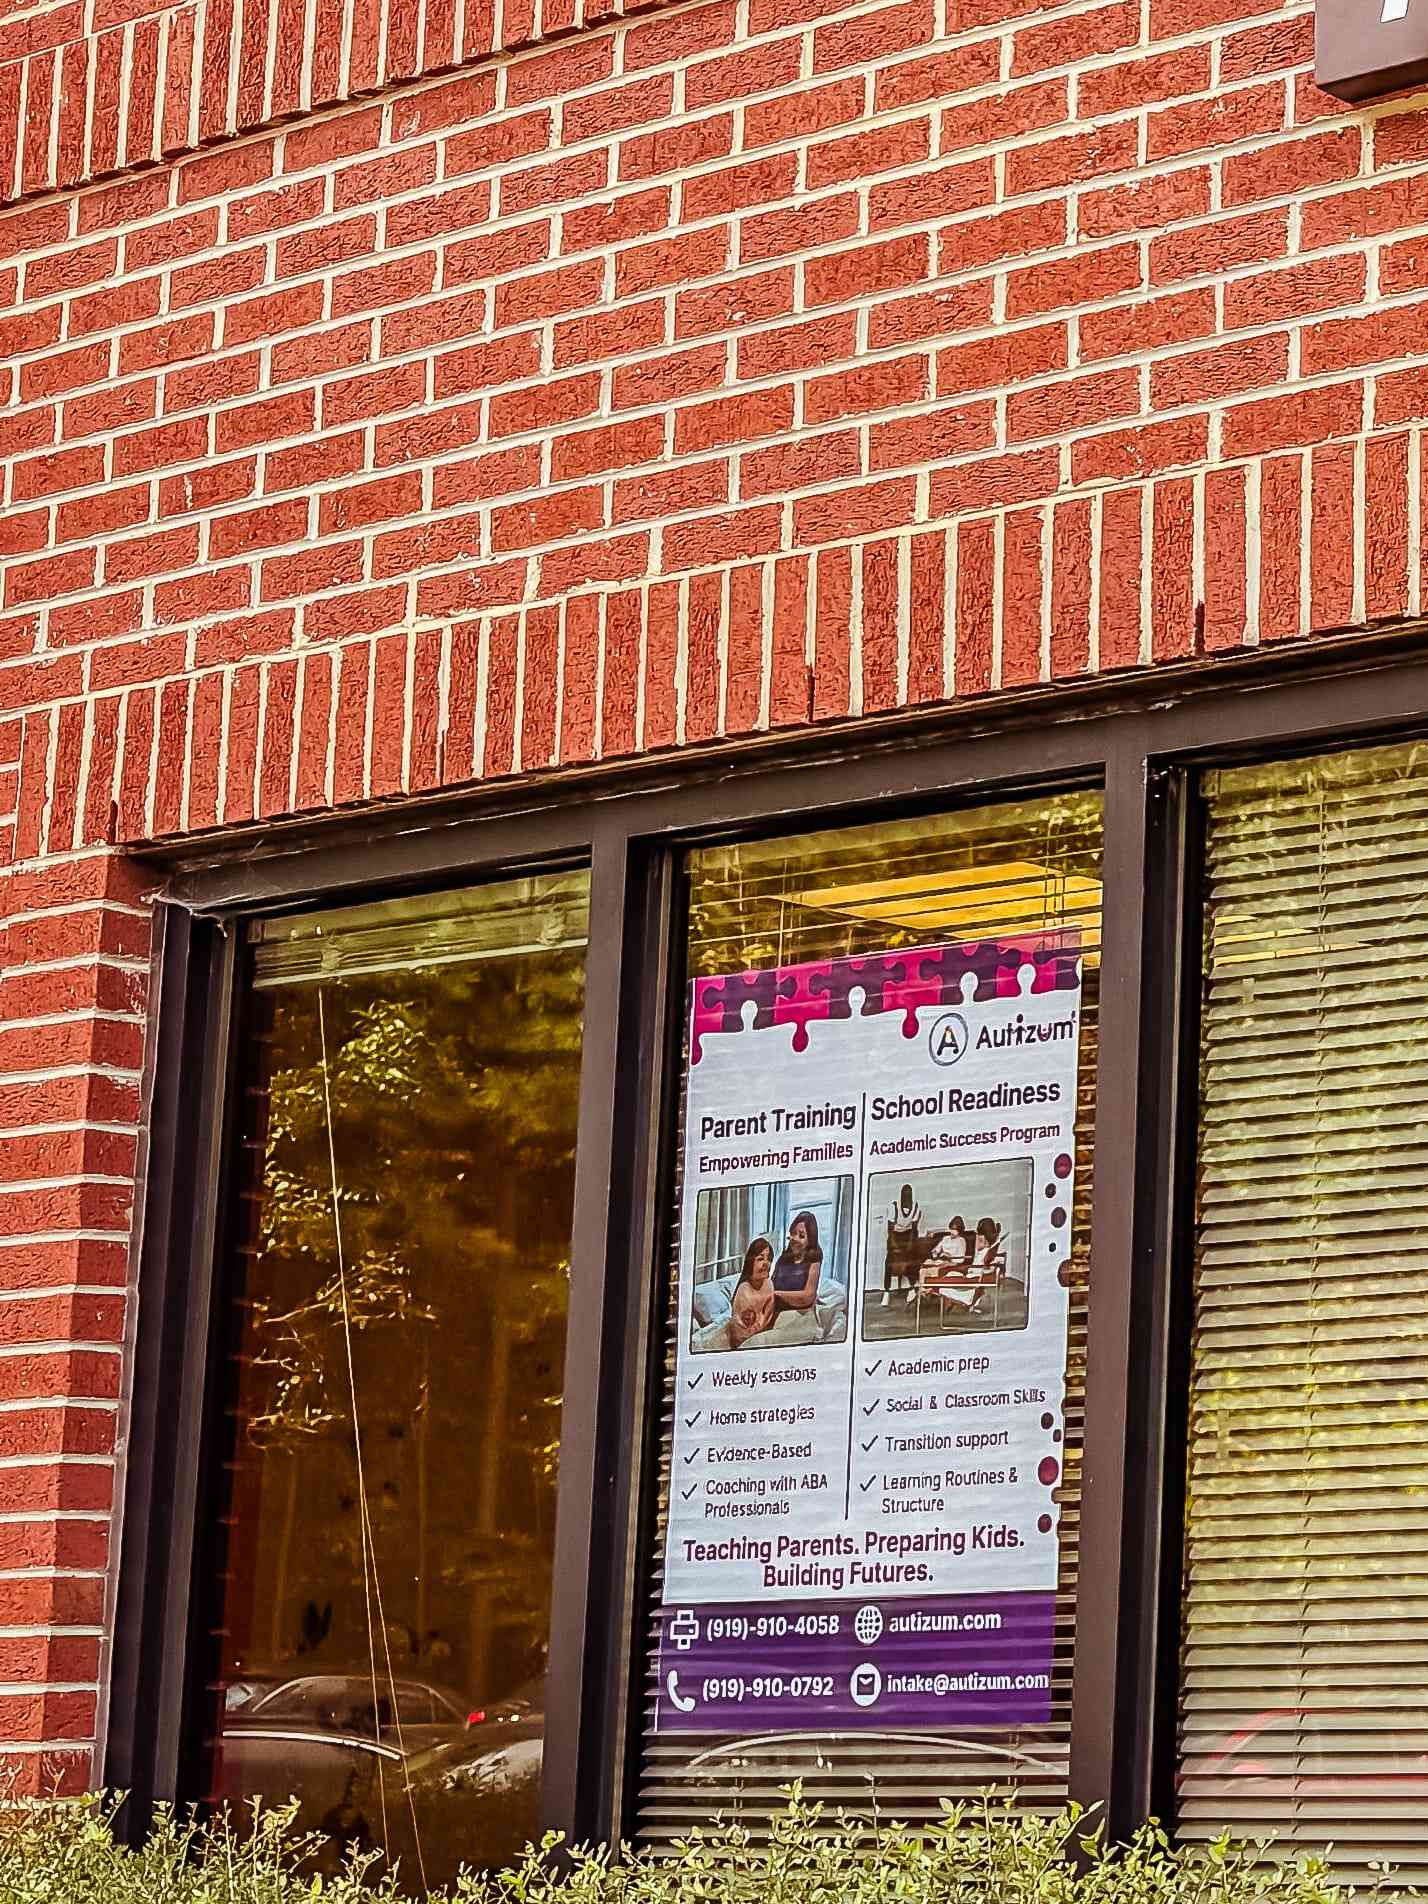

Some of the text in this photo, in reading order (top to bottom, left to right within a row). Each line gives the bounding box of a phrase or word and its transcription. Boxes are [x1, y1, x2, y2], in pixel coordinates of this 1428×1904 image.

[976, 1013, 1074, 1050] Autizum
[871, 1080, 1061, 1122] School Readiness
[701, 1101, 857, 1141] Parent Training
[870, 1123, 1060, 1157] Academic Success Program
[699, 1141, 854, 1175] Empowering Families
[712, 1366, 817, 1389] Weekly sessions
[888, 1356, 990, 1377] Academic prep
[886, 1387, 1046, 1413] Social & Classroom Skills
[710, 1403, 815, 1426] Home strategies
[707, 1442, 812, 1463] Evidence-Based
[885, 1430, 1009, 1452] Transition support
[706, 1473, 828, 1496] Coaching with ABA
[883, 1467, 1018, 1492] Learning Routines &
[704, 1499, 790, 1519] Professionals
[881, 1497, 945, 1514] Structure
[682, 1524, 1025, 1564] Teaching Parents. Preparing Kids.
[763, 1560, 934, 1591] Building Futures.
[706, 1614, 840, 1642] (919)-910-4058
[888, 1612, 1002, 1633] autizum.com
[702, 1676, 835, 1703] (919)-910-0792
[887, 1671, 1050, 1696] intake@autizum.com
